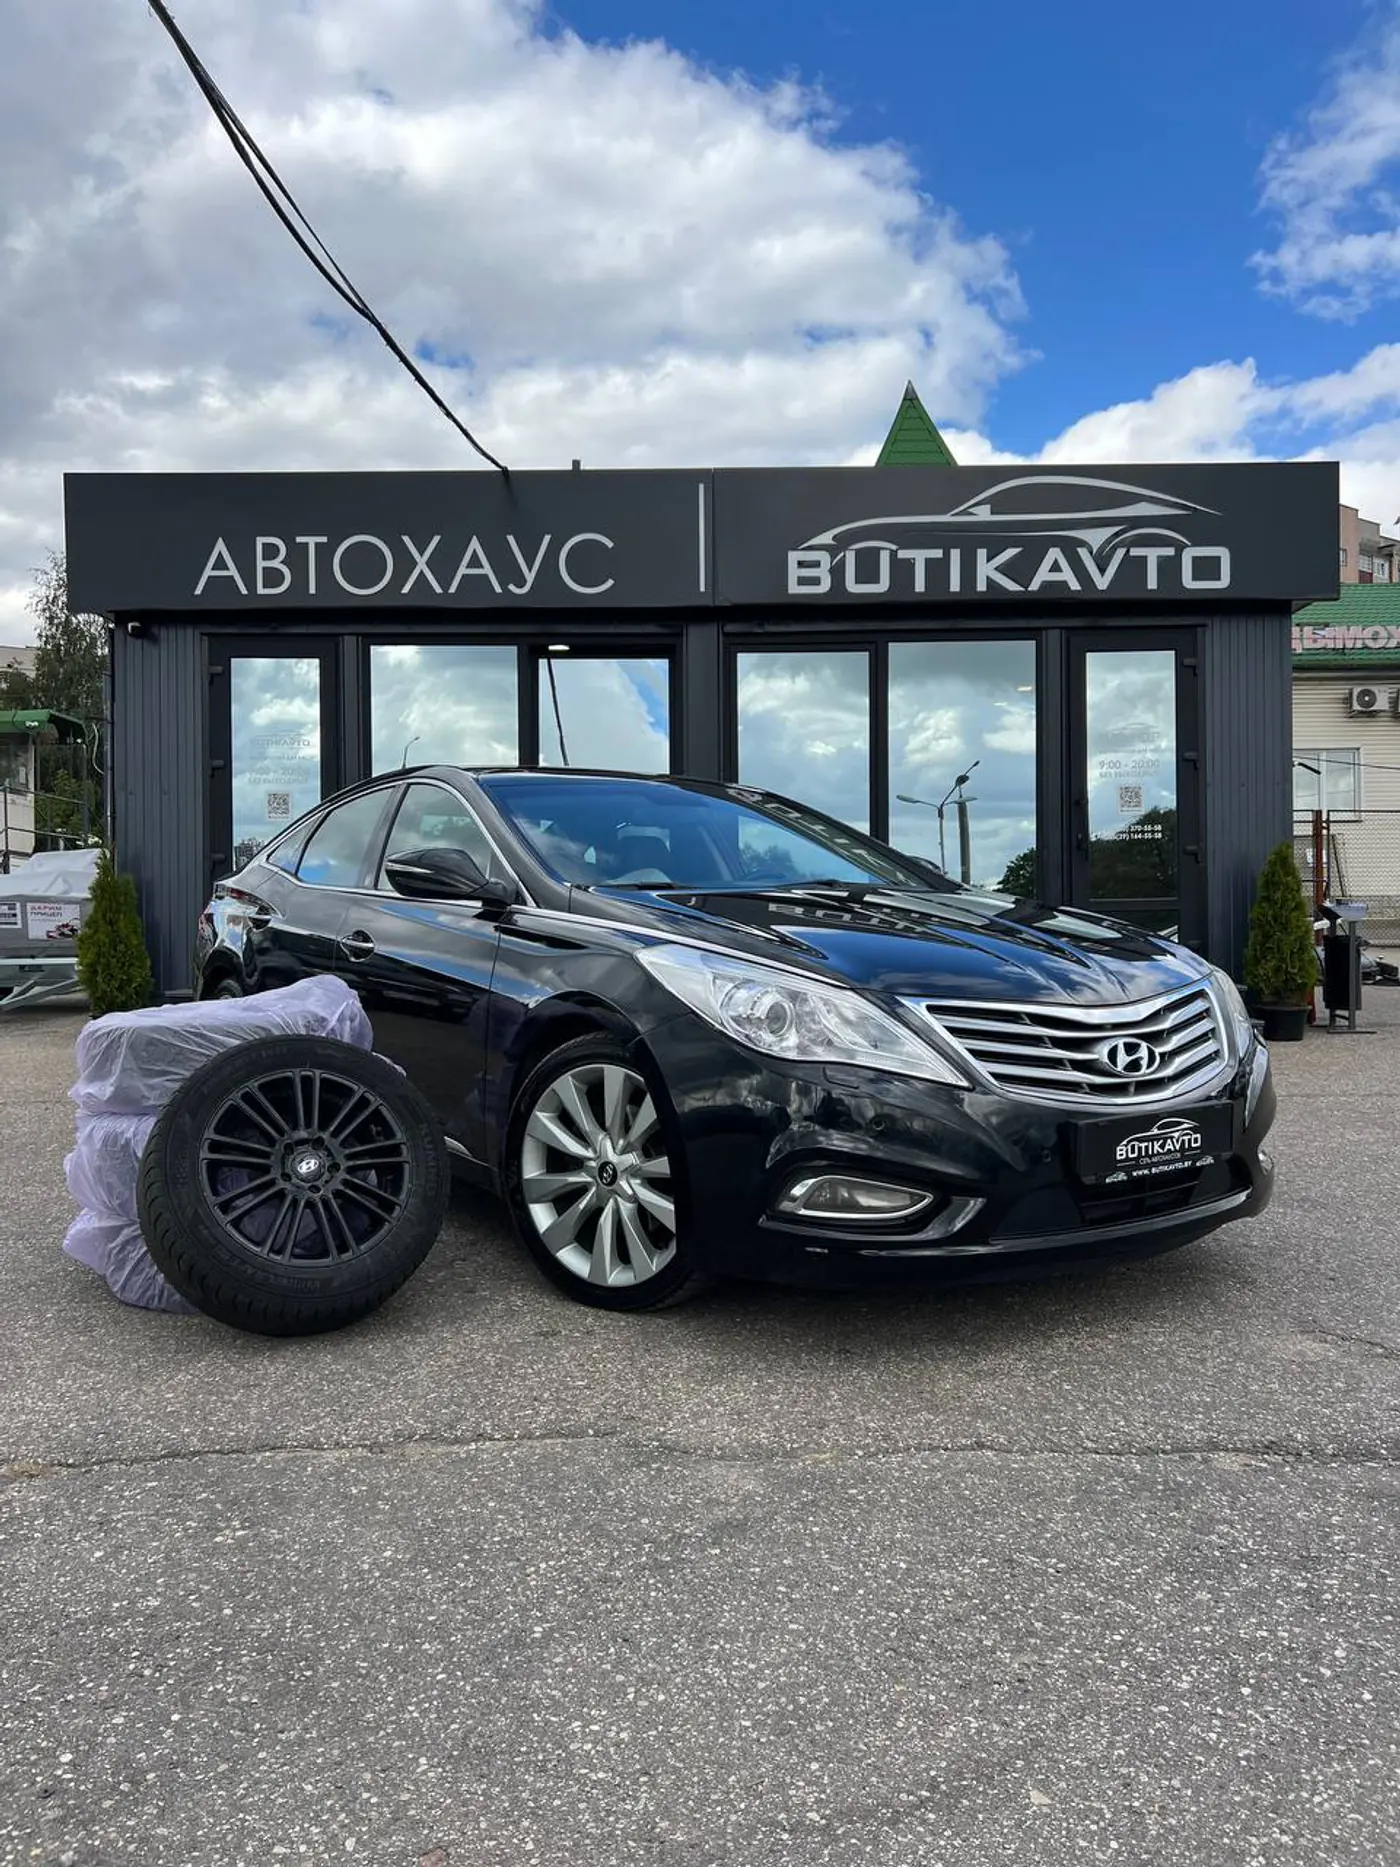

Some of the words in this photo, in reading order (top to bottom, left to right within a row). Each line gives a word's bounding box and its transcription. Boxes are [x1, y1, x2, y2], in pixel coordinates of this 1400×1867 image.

[193, 532, 616, 596] АВТОХАУС
[786, 545, 1232, 595] BUTIKAVTO
[1099, 759, 1121, 770] 9:00
[1131, 759, 1161, 770] 20:00
[1116, 1133, 1201, 1160] BUTIKAVTO
